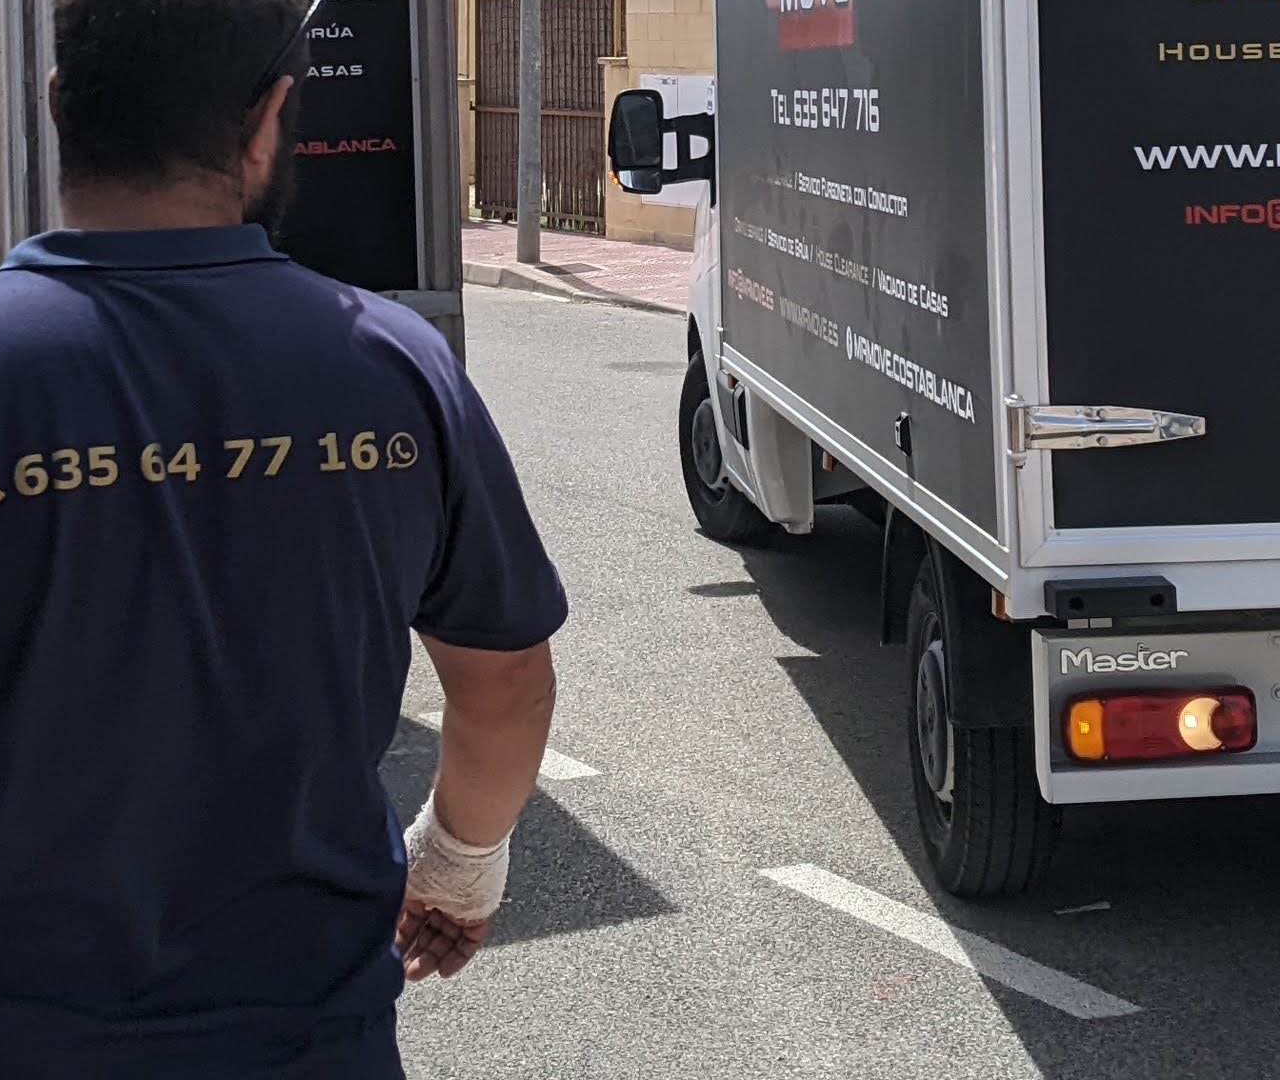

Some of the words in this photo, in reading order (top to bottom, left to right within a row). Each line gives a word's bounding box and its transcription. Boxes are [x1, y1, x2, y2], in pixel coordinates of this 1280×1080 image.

[306, 23, 354, 39] RÚA
[307, 65, 363, 77] ASAS
[771, 89, 791, 126] TEL
[794, 89, 818, 129] 635
[821, 88, 848, 129] 647
[853, 89, 880, 132] 716
[907, 284, 918, 306] DE
[920, 284, 949, 318] CASAS
[14, 445, 119, 497] 635
[141, 442, 201, 483] 64
[223, 435, 293, 479] 77
[318, 431, 379, 472] 16
[1061, 642, 1189, 675] Master
